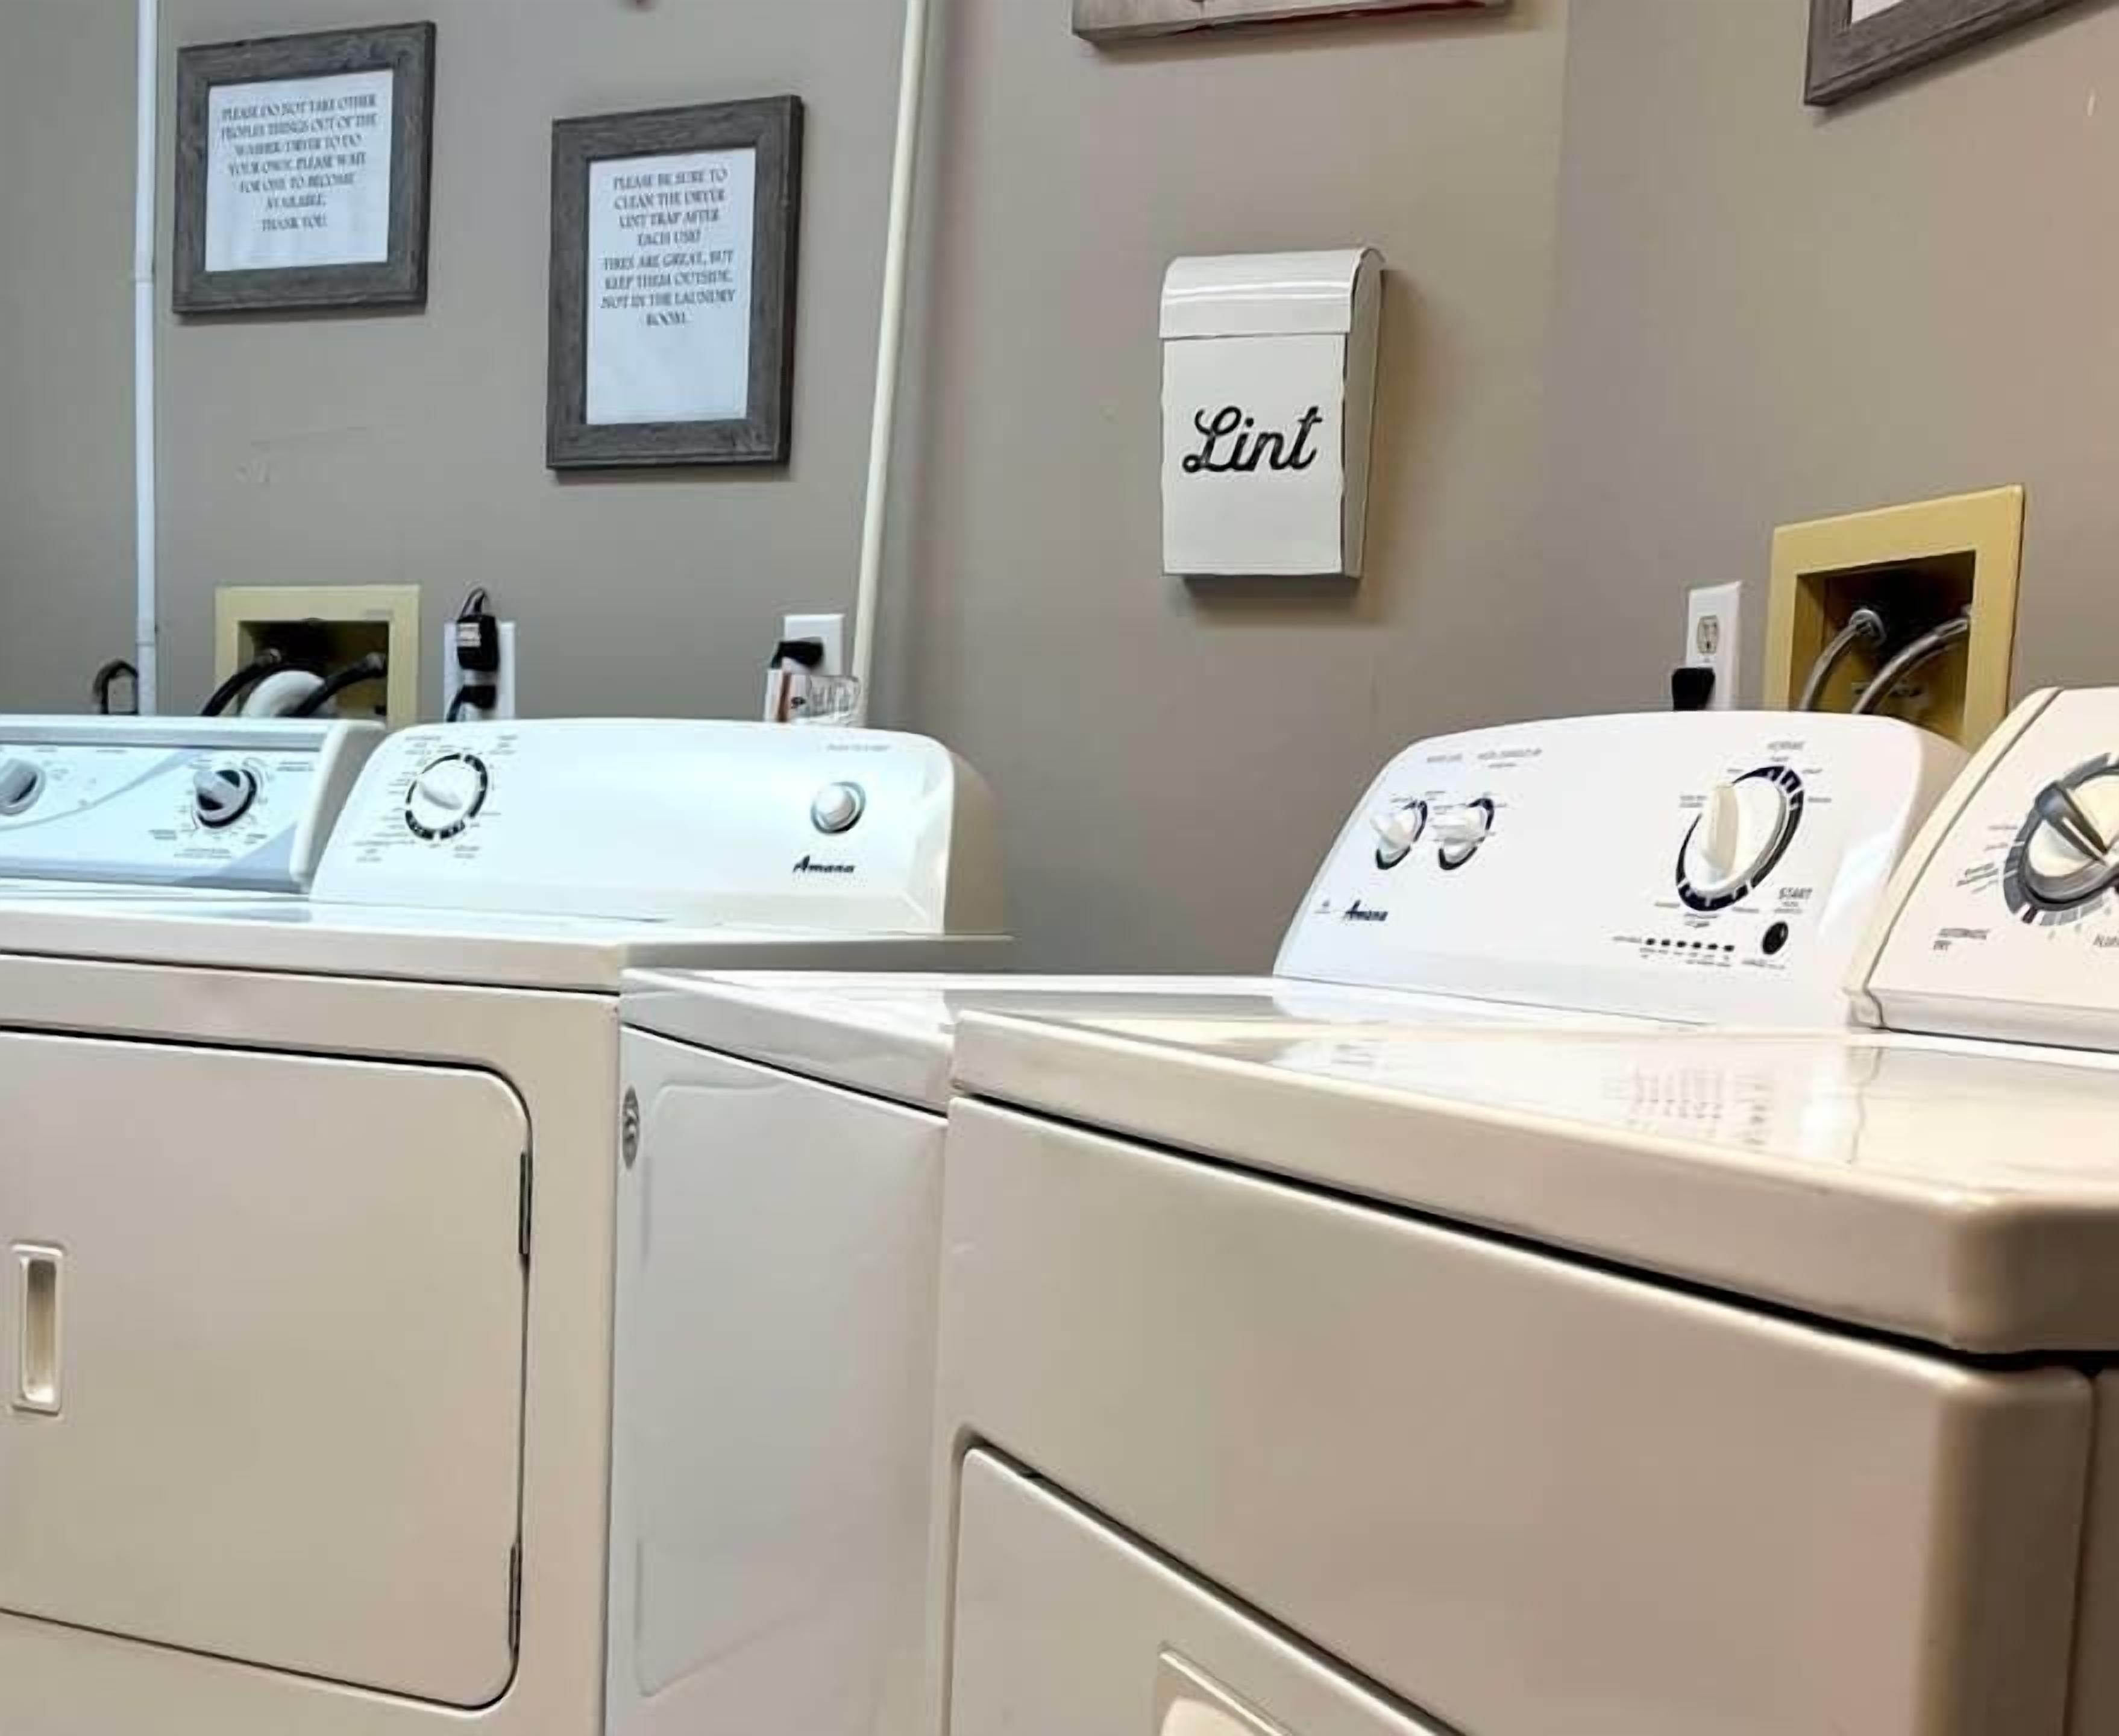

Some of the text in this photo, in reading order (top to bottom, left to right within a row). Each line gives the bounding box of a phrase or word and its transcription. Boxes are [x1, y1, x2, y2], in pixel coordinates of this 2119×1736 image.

[614, 167, 729, 190] PLEASE BE SURE TO
[614, 192, 655, 210] CLEAN
[656, 190, 682, 207] THE
[637, 231, 671, 247] EACH
[1182, 405, 1323, 473] Lint
[792, 855, 856, 873] Amana
[1343, 899, 1388, 922] Amana
